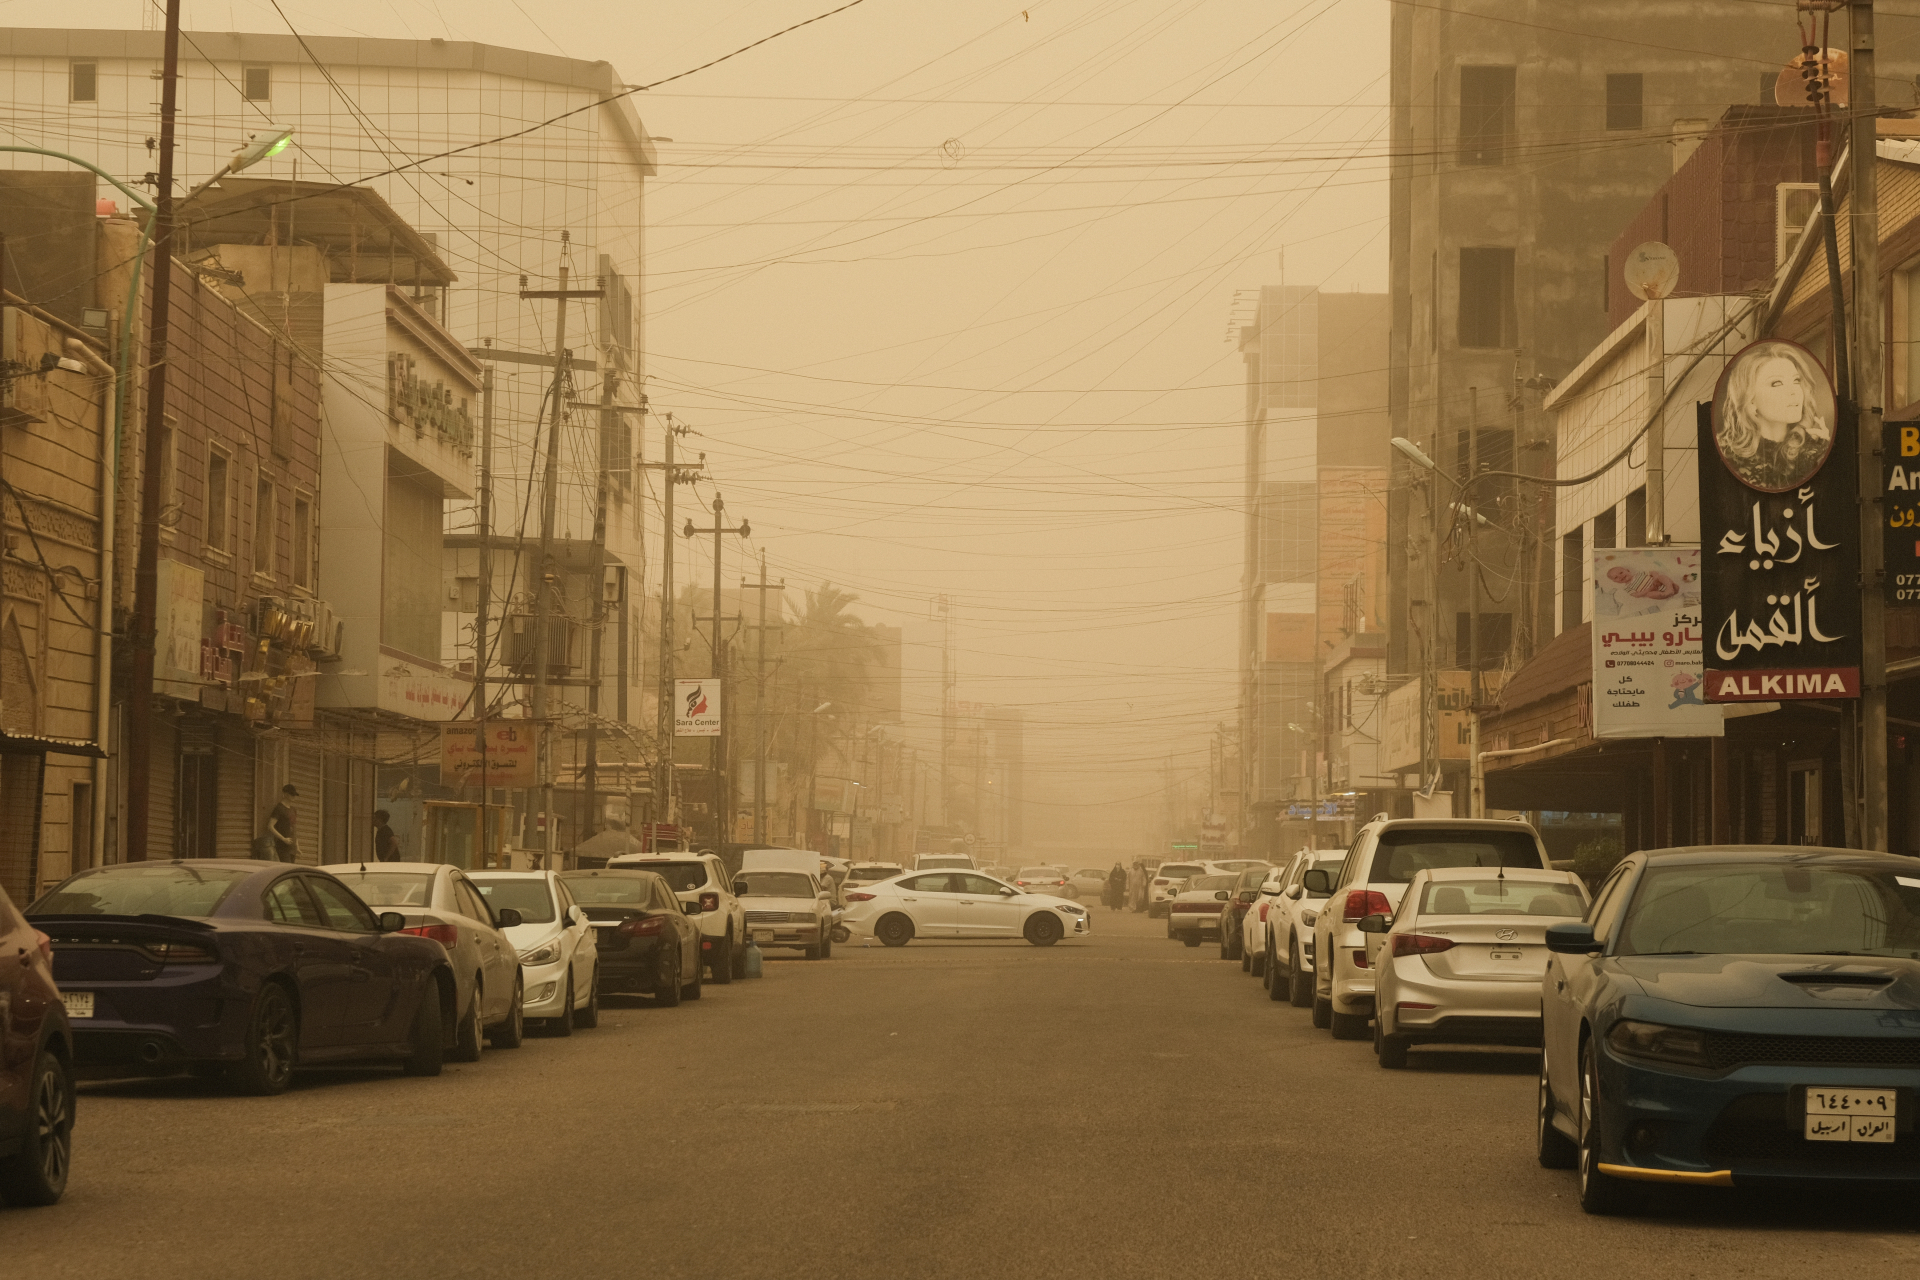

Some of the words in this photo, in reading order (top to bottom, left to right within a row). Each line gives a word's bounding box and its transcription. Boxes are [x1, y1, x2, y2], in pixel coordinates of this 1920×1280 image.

[1717, 486, 1841, 571] أزياء
[1673, 613, 1702, 627] ركز
[1602, 632, 1654, 647] بيبي
[1662, 627, 1702, 646] ارو
[1618, 675, 1633, 684] كل
[1718, 672, 1846, 696] ALKIMA
[1612, 700, 1640, 708] طفلك
[1816, 1093, 1887, 1111] ٦٤٤٠٠٩
[1811, 1120, 1846, 1134] اربيل
[1857, 1121, 1889, 1137] العراق
